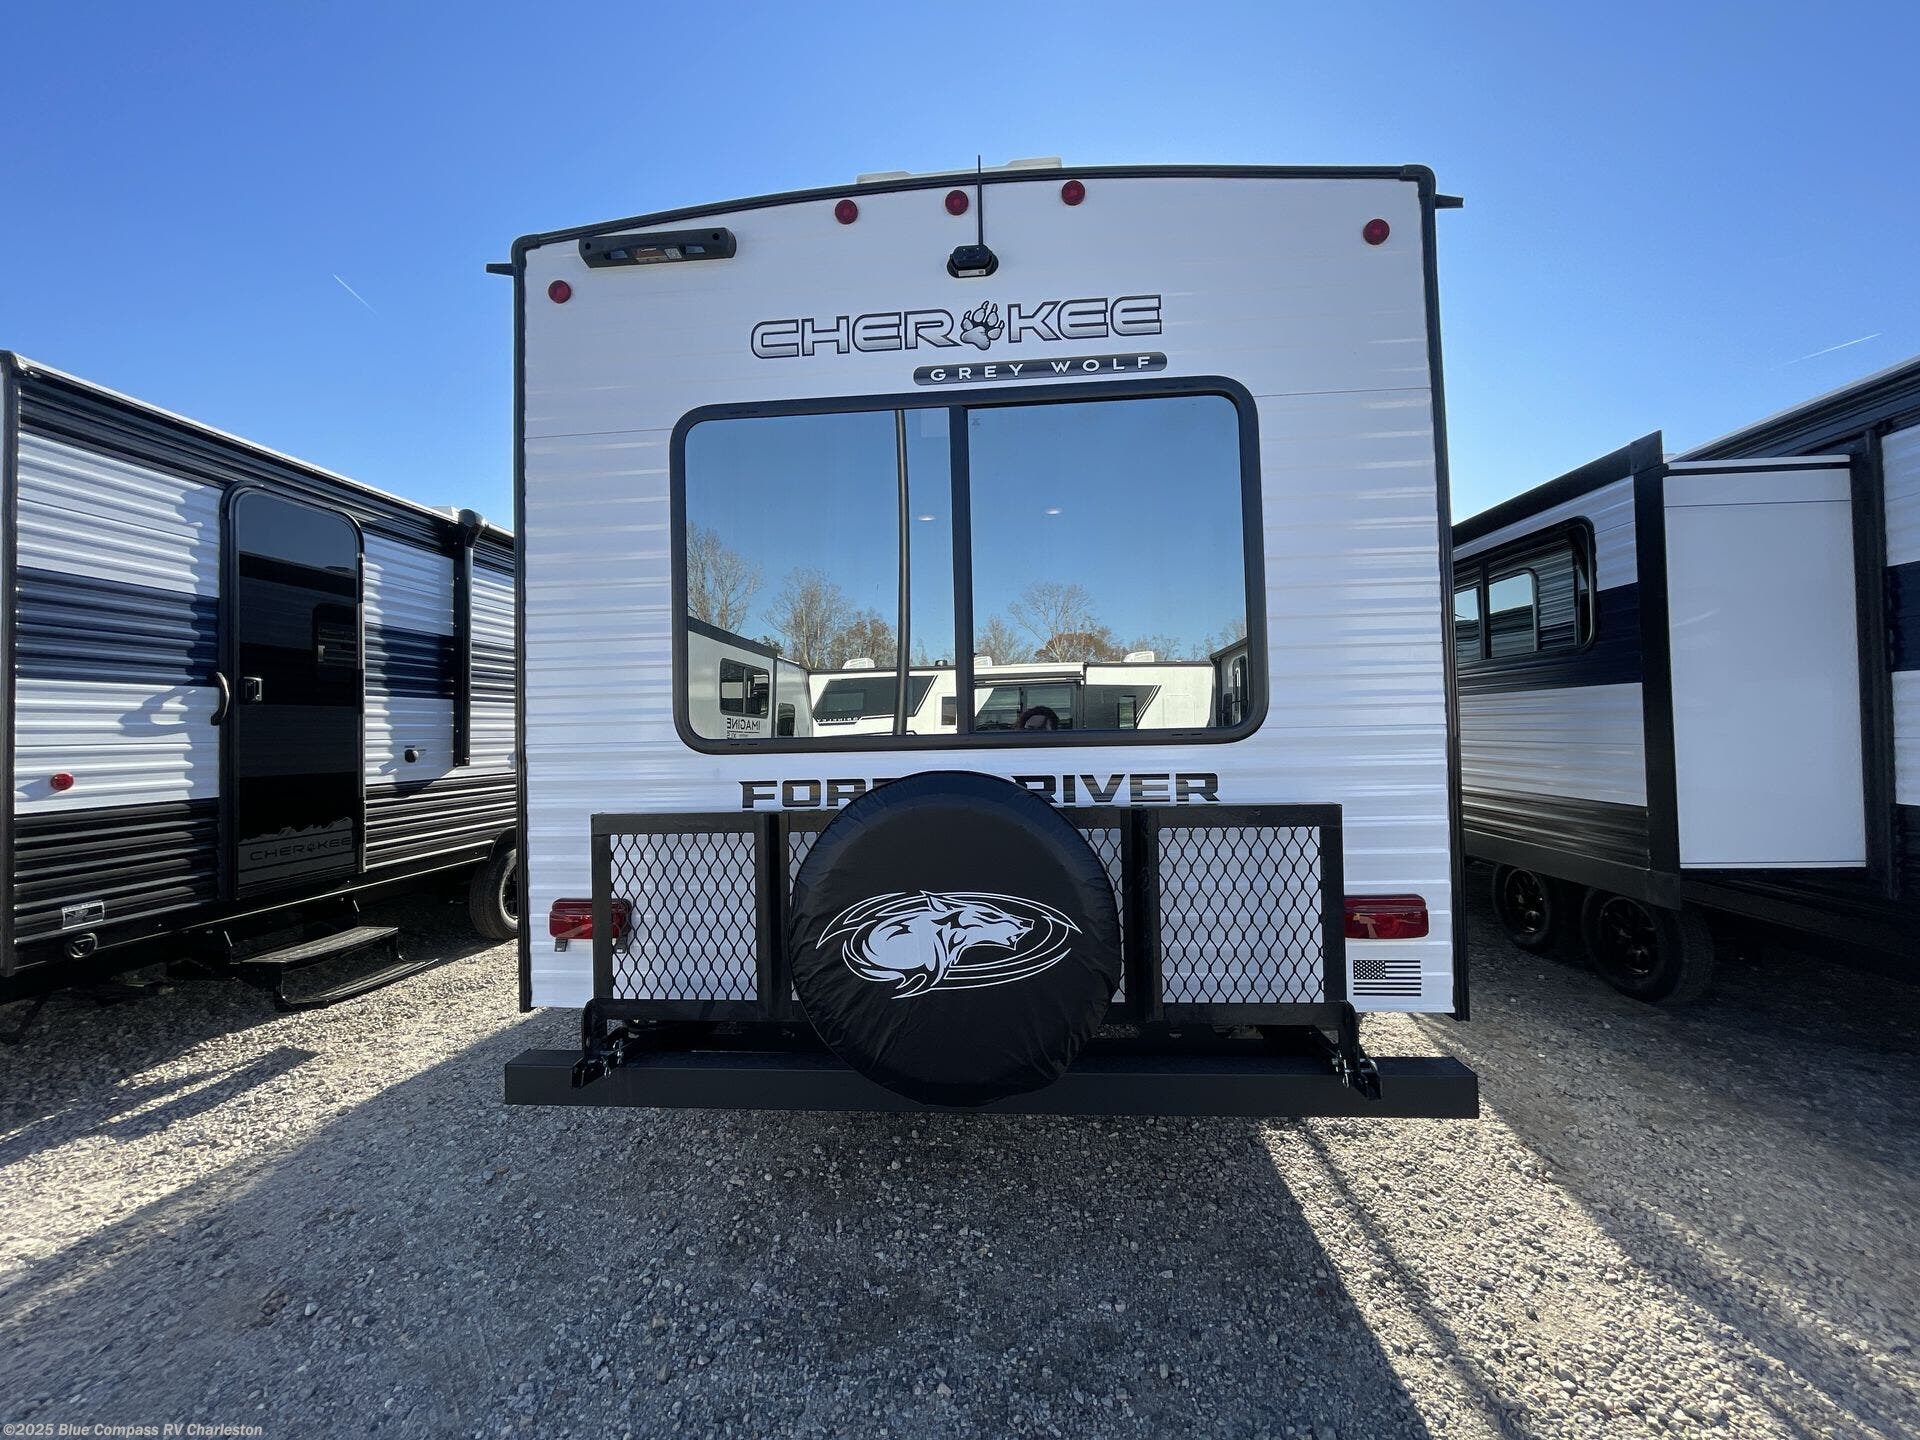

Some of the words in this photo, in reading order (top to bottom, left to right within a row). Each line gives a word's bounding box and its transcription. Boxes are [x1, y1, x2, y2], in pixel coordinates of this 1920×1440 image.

[930, 363, 1024, 382] GREY
[1050, 356, 1152, 374] WOLF
[738, 777, 900, 809] FOR
[1011, 772, 1221, 804] RIVER
